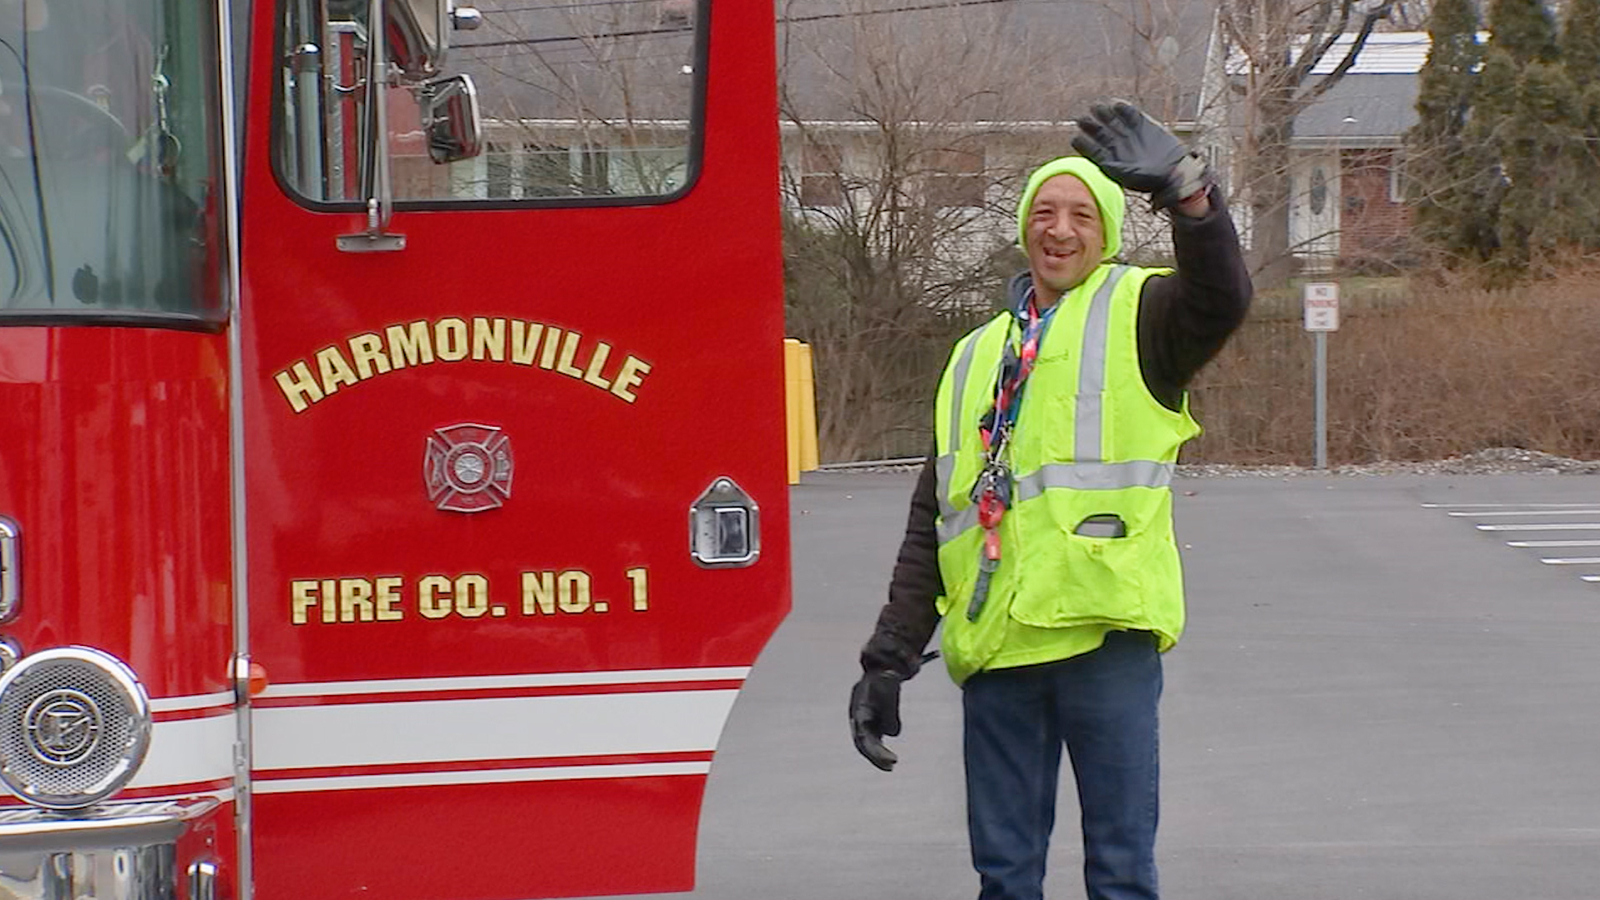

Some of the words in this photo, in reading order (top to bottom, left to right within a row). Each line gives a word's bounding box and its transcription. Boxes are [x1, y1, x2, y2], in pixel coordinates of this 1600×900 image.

[273, 316, 652, 414] HARMONVILLE
[291, 576, 403, 625] FIRE
[418, 573, 506, 620] CO.
[521, 568, 609, 616] NO.
[625, 566, 649, 611] 1
